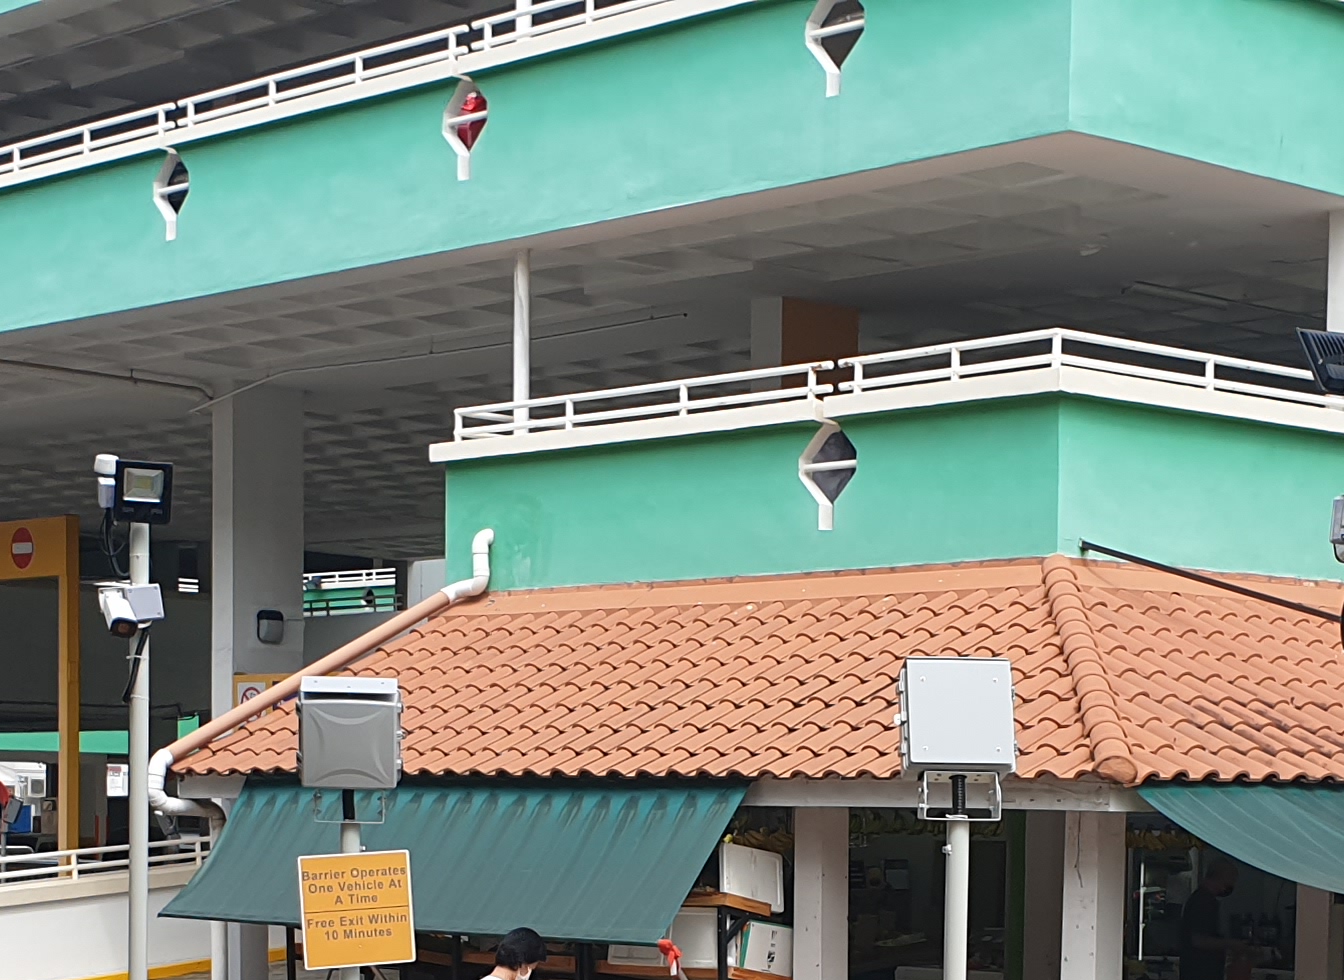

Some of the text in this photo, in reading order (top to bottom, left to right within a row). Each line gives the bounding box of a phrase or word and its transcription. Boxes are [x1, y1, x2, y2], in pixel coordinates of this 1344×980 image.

[302, 866, 406, 882] Barrier Operates
[308, 878, 402, 894] One Vehicle At
[334, 894, 378, 906] A Time
[306, 913, 407, 929] Free Exit Within
[324, 928, 392, 940] 10 Minutes
